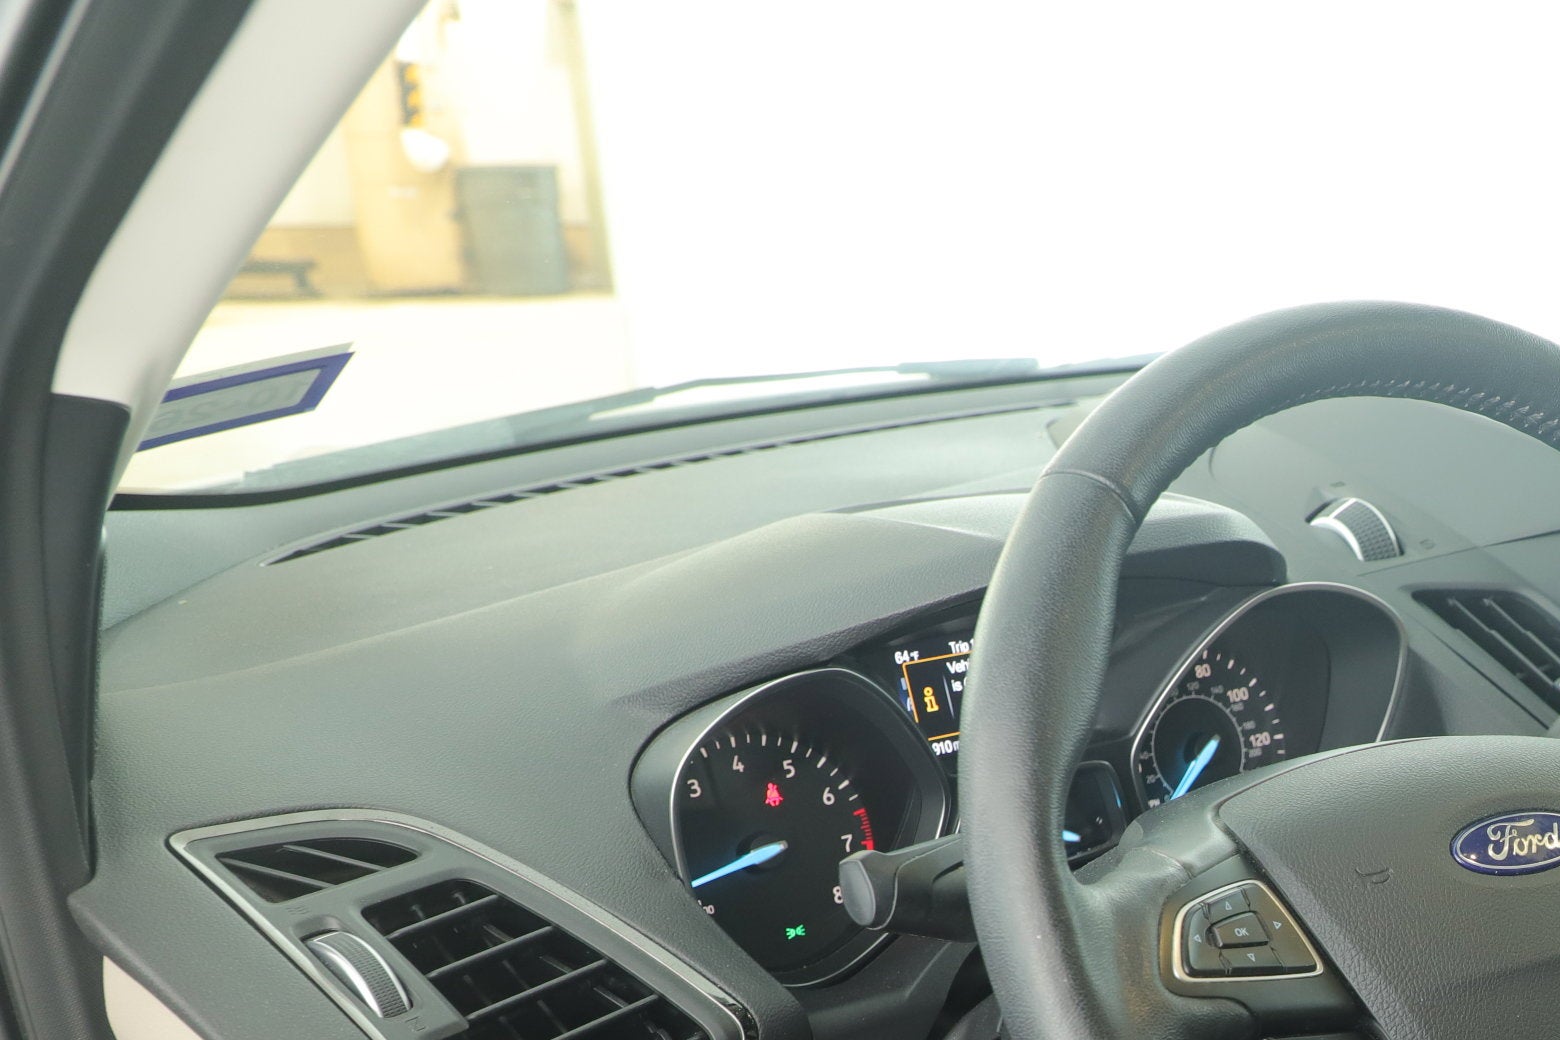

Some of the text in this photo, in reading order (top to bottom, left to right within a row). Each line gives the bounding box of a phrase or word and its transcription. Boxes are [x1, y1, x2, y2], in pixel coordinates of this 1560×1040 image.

[948, 640, 969, 654] Trip
[946, 658, 969, 674] Veh
[1194, 664, 1211, 679] 80
[951, 679, 963, 692] is
[1227, 687, 1249, 703] 100
[1249, 732, 1271, 748] 120
[732, 755, 744, 772] 4
[783, 759, 796, 778] 5
[687, 779, 702, 798] 3
[822, 787, 835, 805] 6
[841, 834, 853, 852] 7
[1234, 927, 1249, 937] OK
